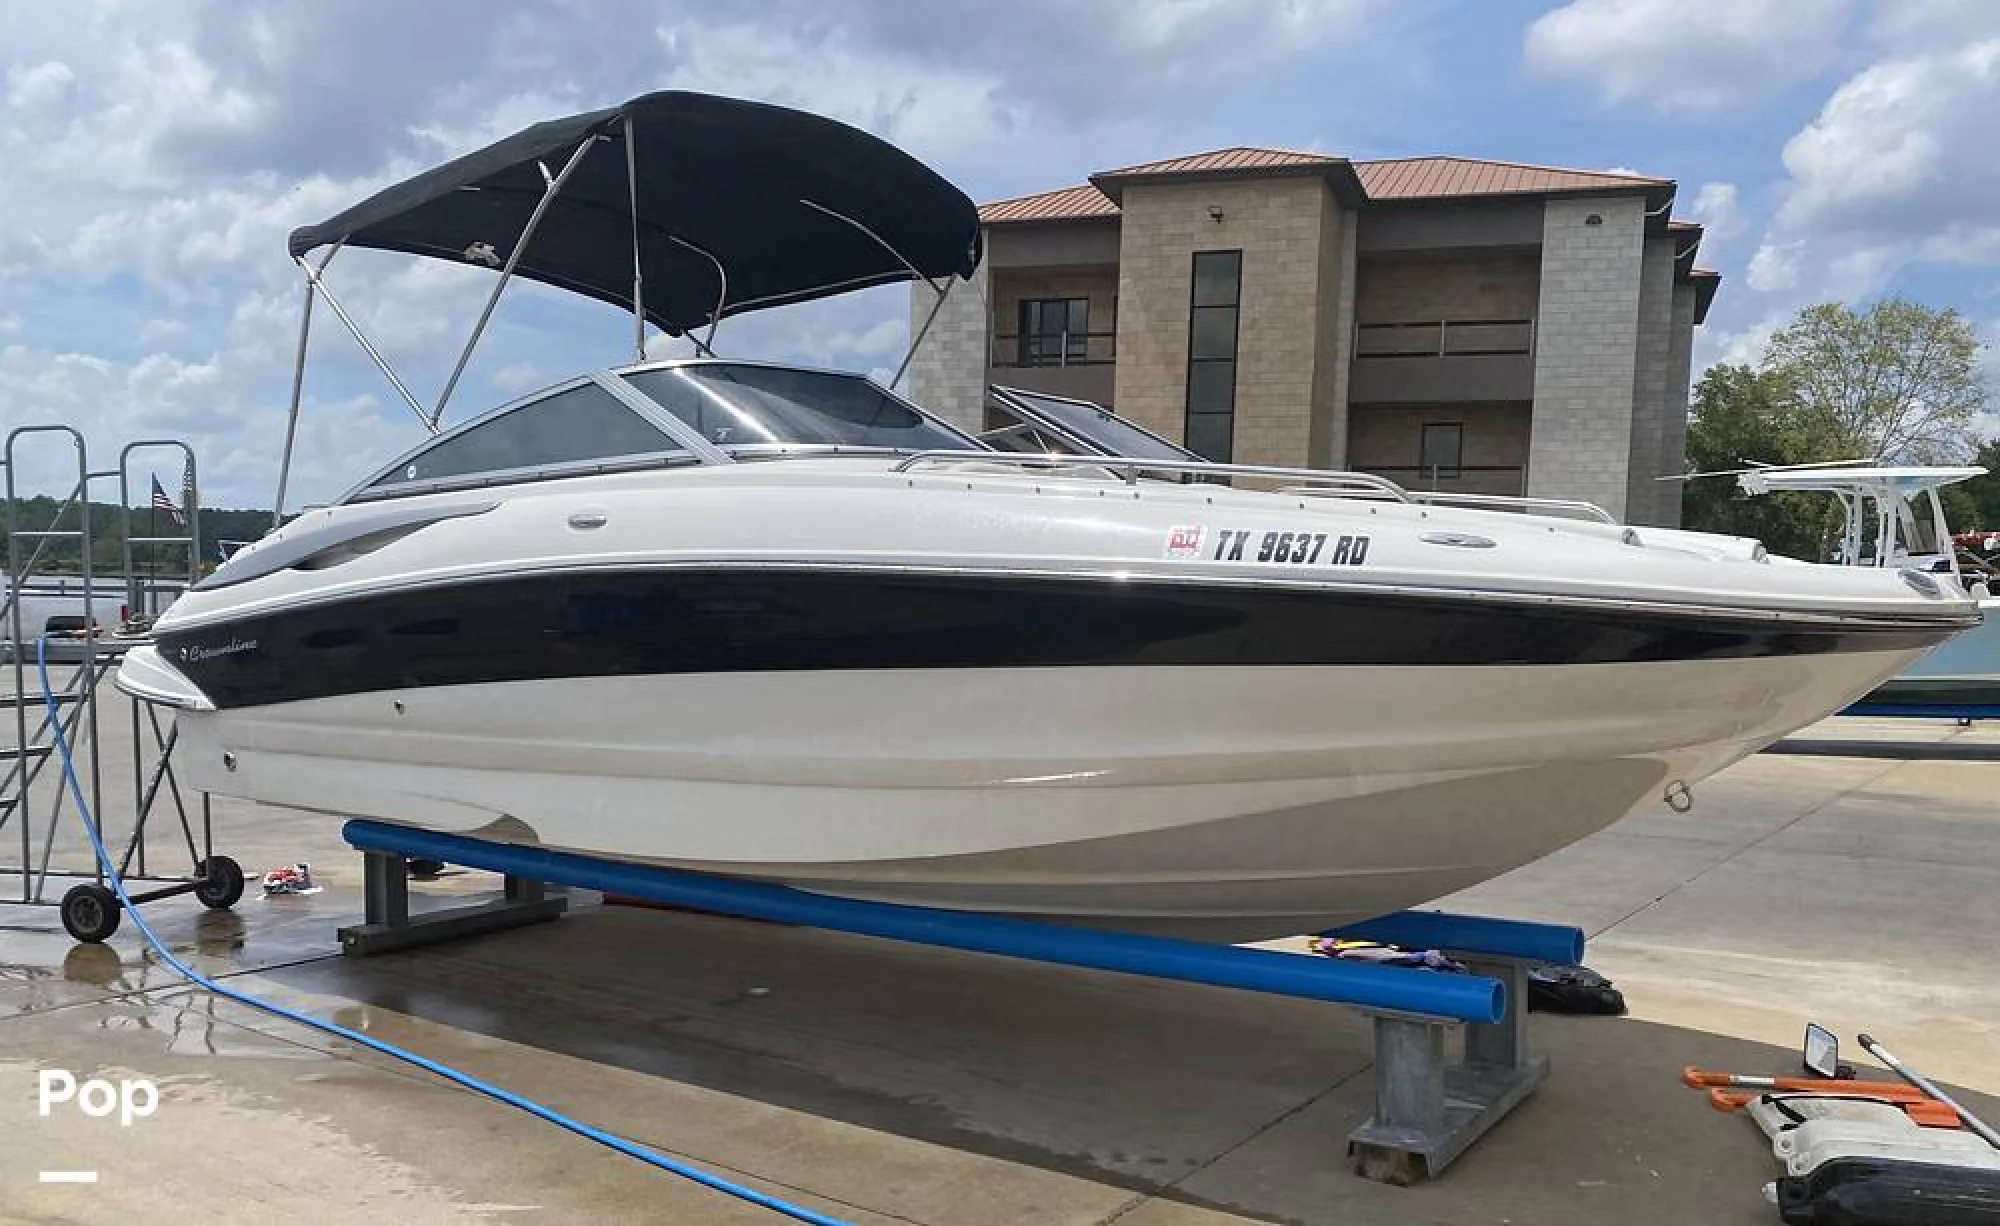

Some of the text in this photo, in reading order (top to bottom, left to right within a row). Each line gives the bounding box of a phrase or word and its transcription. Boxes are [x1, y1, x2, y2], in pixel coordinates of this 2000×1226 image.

[1213, 530, 1251, 560] TX
[1257, 532, 1328, 564] 9637
[1331, 535, 1370, 565] RD
